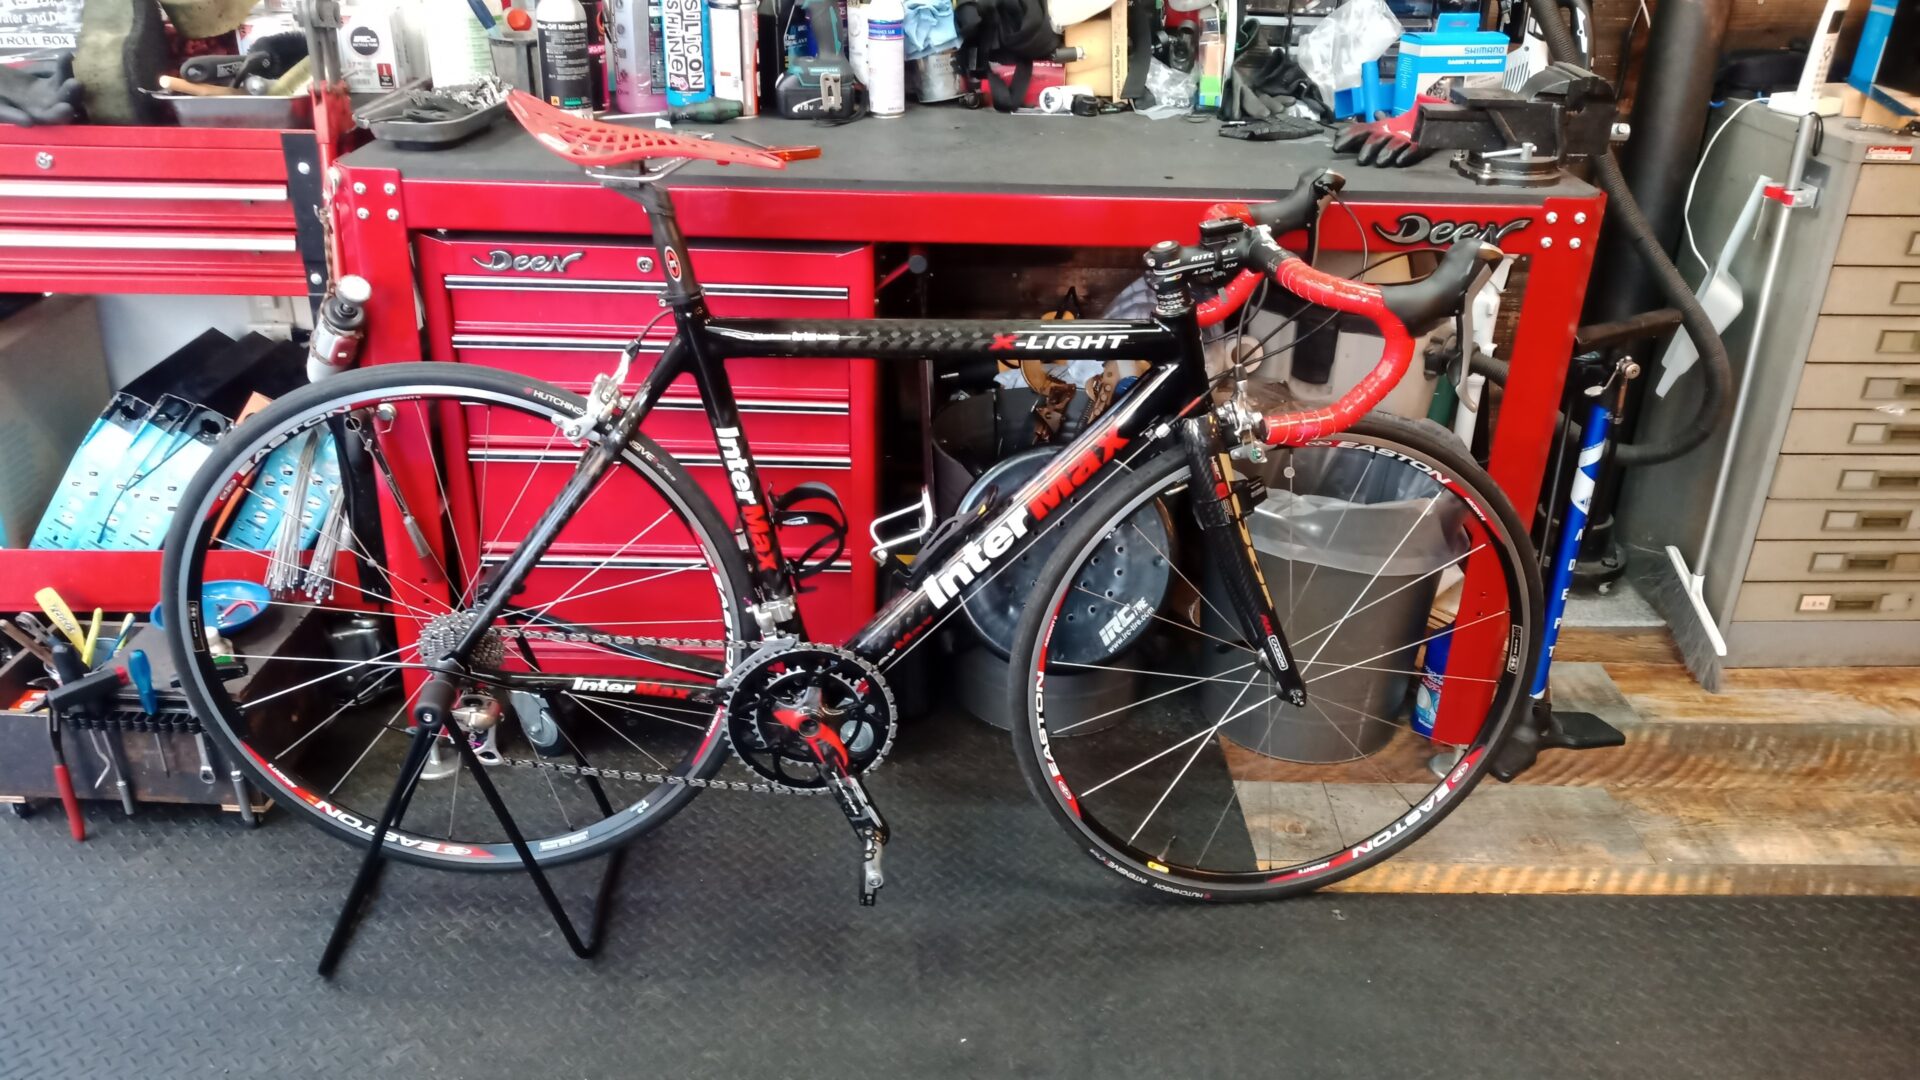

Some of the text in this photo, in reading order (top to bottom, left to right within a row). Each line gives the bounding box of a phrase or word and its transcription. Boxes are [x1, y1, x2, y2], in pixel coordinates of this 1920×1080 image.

[42, 35, 69, 45] BOX
[1464, 46, 1505, 55] SHIMANO
[1190, 247, 1237, 262] RITCEY
[1157, 291, 1183, 299] OOK
[1159, 297, 1185, 305] OOK
[988, 332, 1130, 351] X-LIGHT
[1335, 440, 1453, 485] EASTON
[1107, 606, 1156, 654] www.irc-tire.com
[1035, 670, 1061, 777] EASTON
[1351, 782, 1451, 860] EASTON
